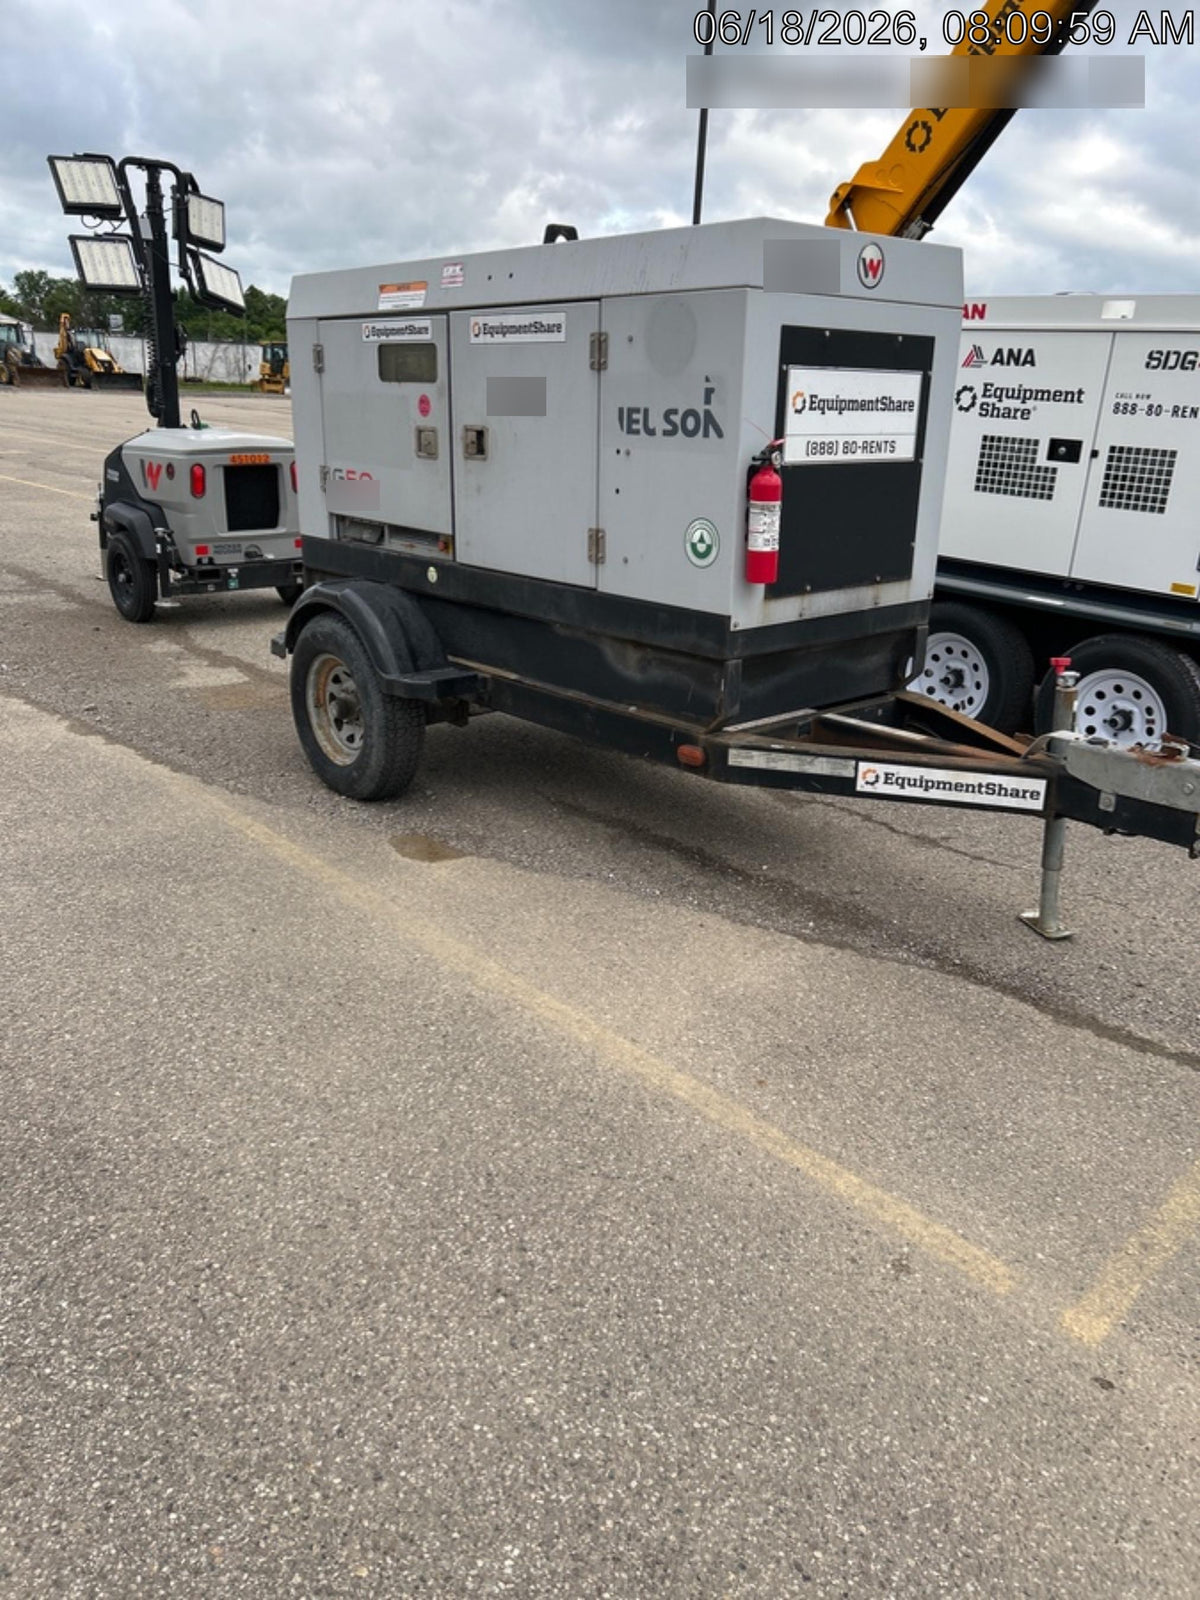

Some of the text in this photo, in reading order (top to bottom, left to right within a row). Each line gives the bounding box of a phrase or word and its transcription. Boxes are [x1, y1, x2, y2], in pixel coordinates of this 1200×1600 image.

[371, 324, 429, 337] EquipmentShare
[482, 321, 562, 338] EquipmentShare
[990, 348, 1036, 367] ANA
[981, 382, 1085, 404] Equipment
[808, 394, 915, 415] EquipmentShare
[978, 402, 1031, 420] Share
[1112, 402, 1199, 419] 888-80-REN
[806, 440, 897, 456] (888) 80-RENTS
[882, 771, 1041, 800] EquipmentShare
